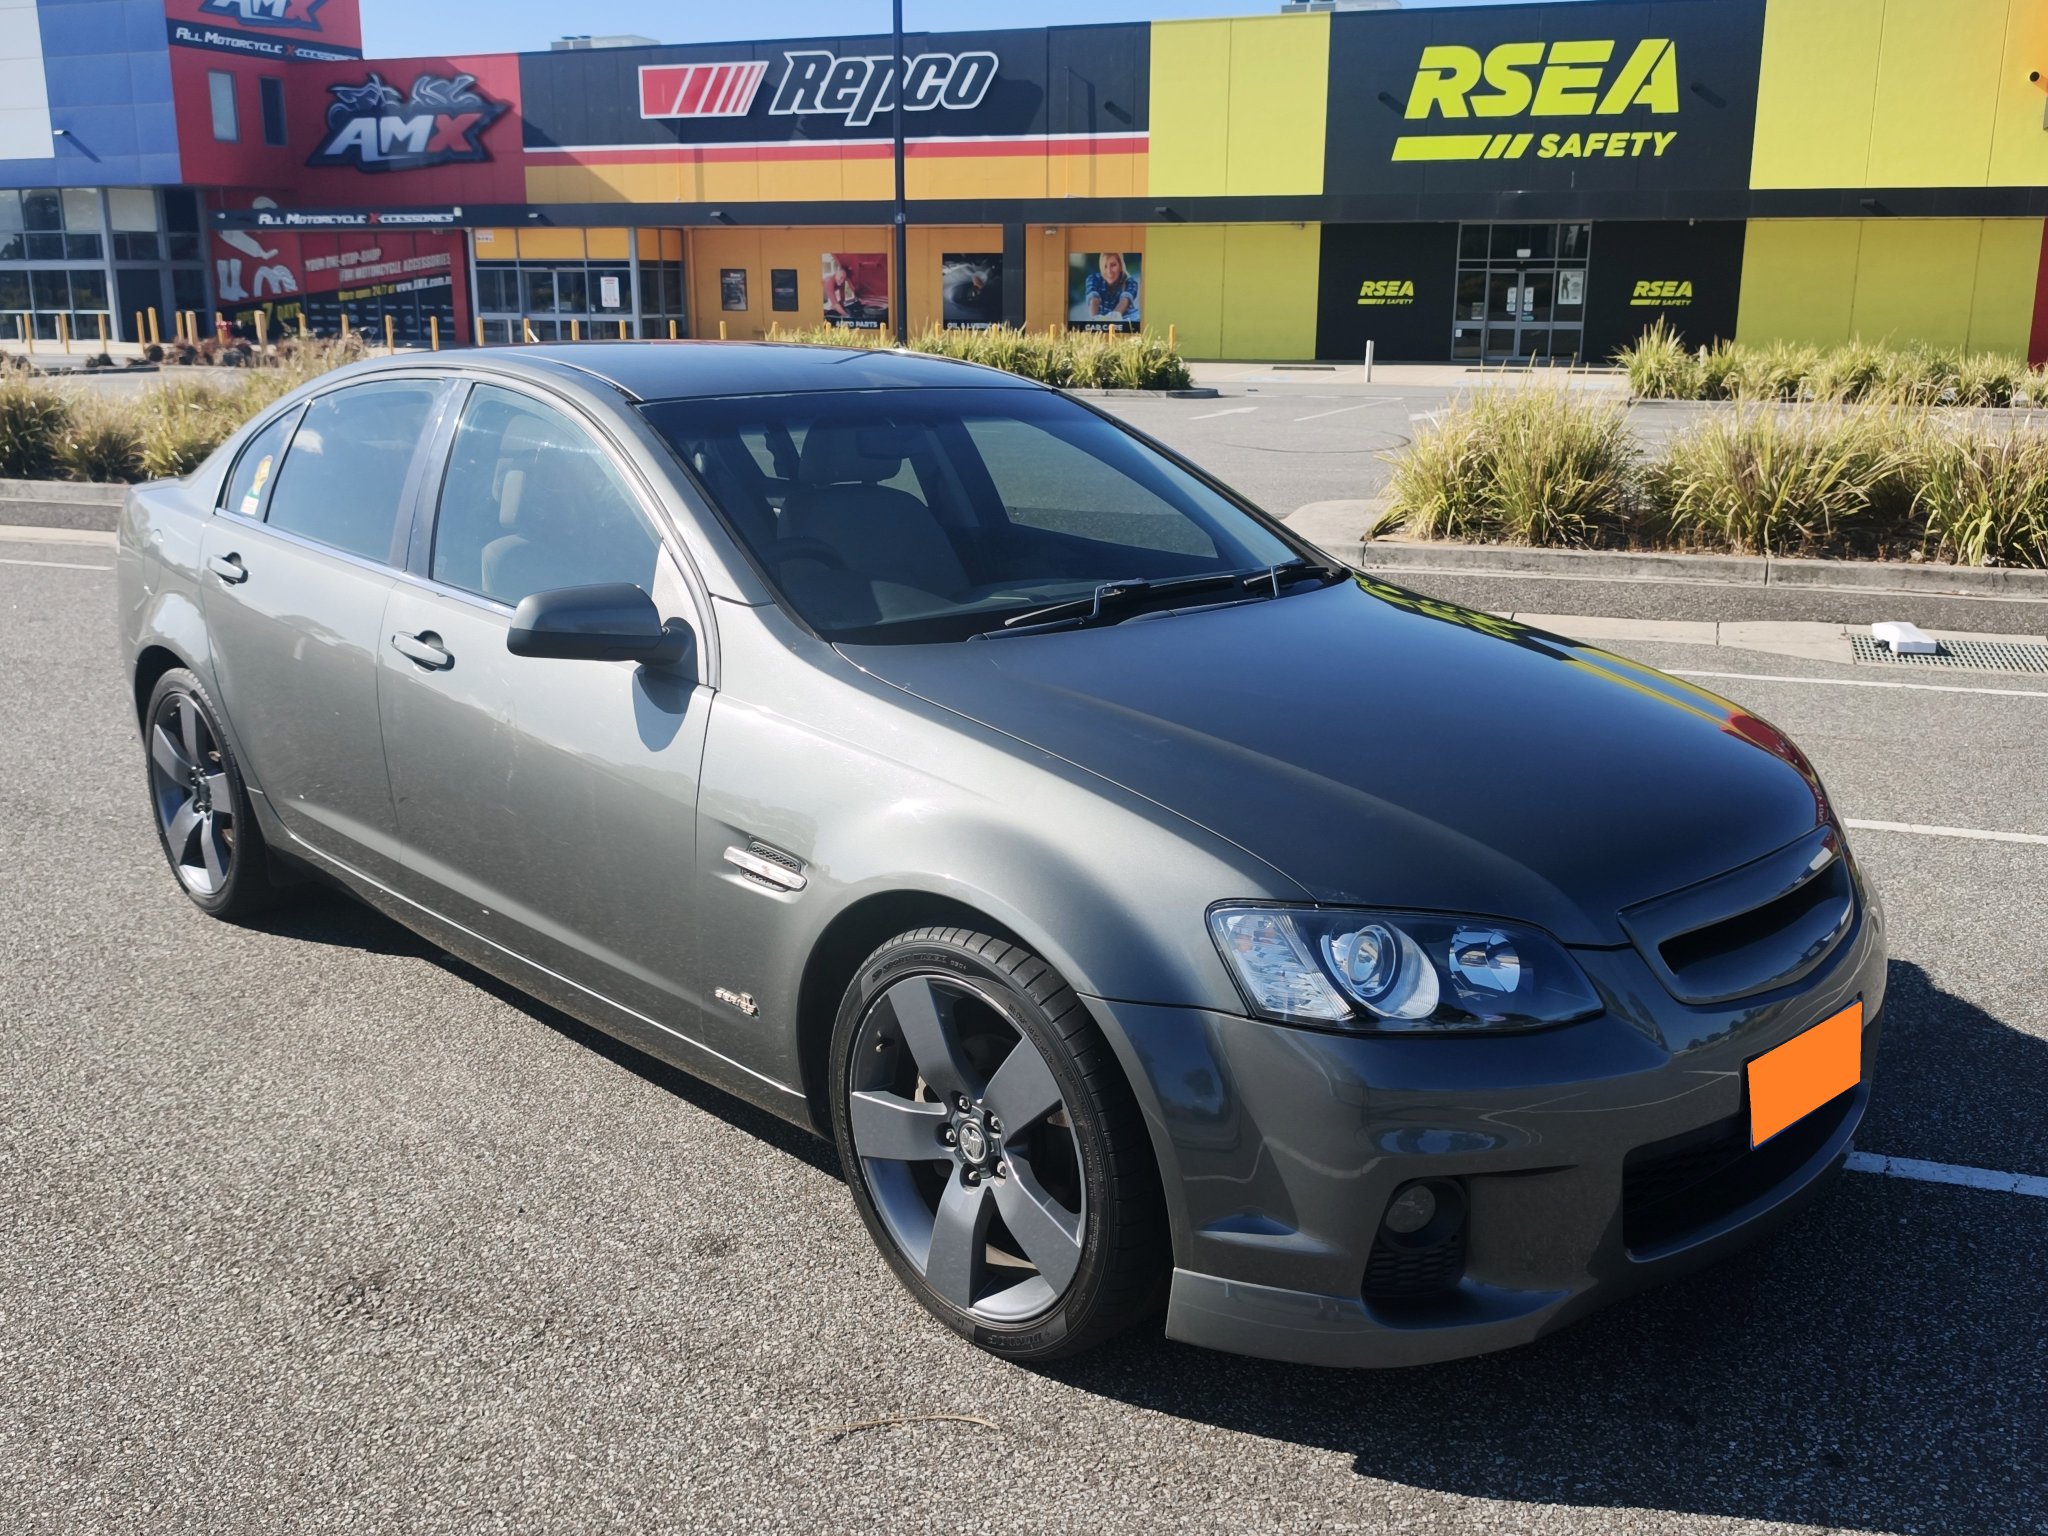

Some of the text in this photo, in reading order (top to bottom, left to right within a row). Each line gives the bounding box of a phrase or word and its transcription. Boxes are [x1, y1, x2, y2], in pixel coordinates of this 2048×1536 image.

[175, 27, 203, 42] ALL
[204, 31, 283, 54] MOTORCYCLE
[768, 51, 999, 126] Repco
[1404, 39, 1679, 119] RSEA
[324, 113, 483, 162] AMX
[1537, 132, 1677, 158] SAFETY
[258, 213, 284, 225] ALL
[285, 212, 367, 225] MOTORCYCLE
[1360, 281, 1414, 297] RSEA
[1633, 281, 1692, 297] RSEA
